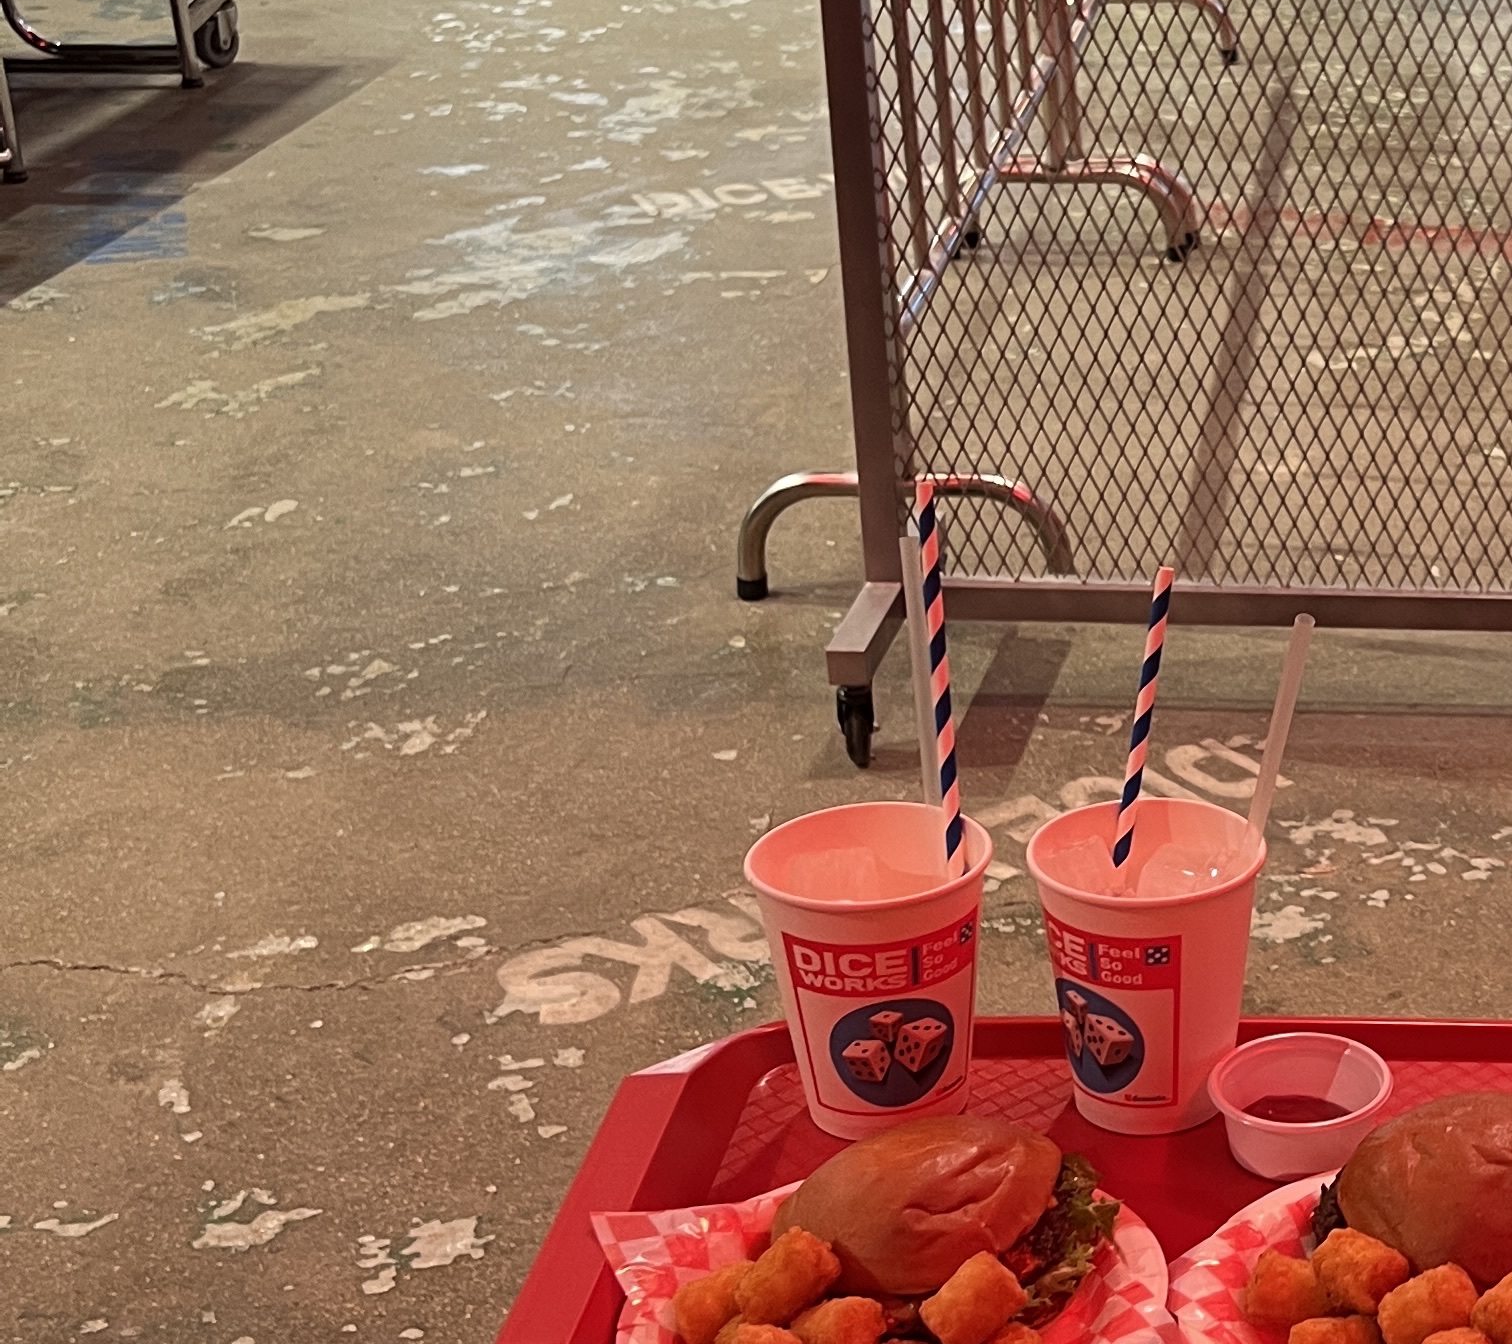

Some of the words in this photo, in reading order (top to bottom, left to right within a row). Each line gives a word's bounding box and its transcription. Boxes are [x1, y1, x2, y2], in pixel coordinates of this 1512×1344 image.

[922, 930, 958, 955] Feel
[1098, 943, 1140, 959] Feel
[792, 944, 907, 976] DICE
[922, 953, 944, 967] So
[923, 958, 958, 981] Good
[1099, 957, 1122, 971] So
[798, 969, 907, 992] WORKS
[1101, 971, 1142, 985] Good
